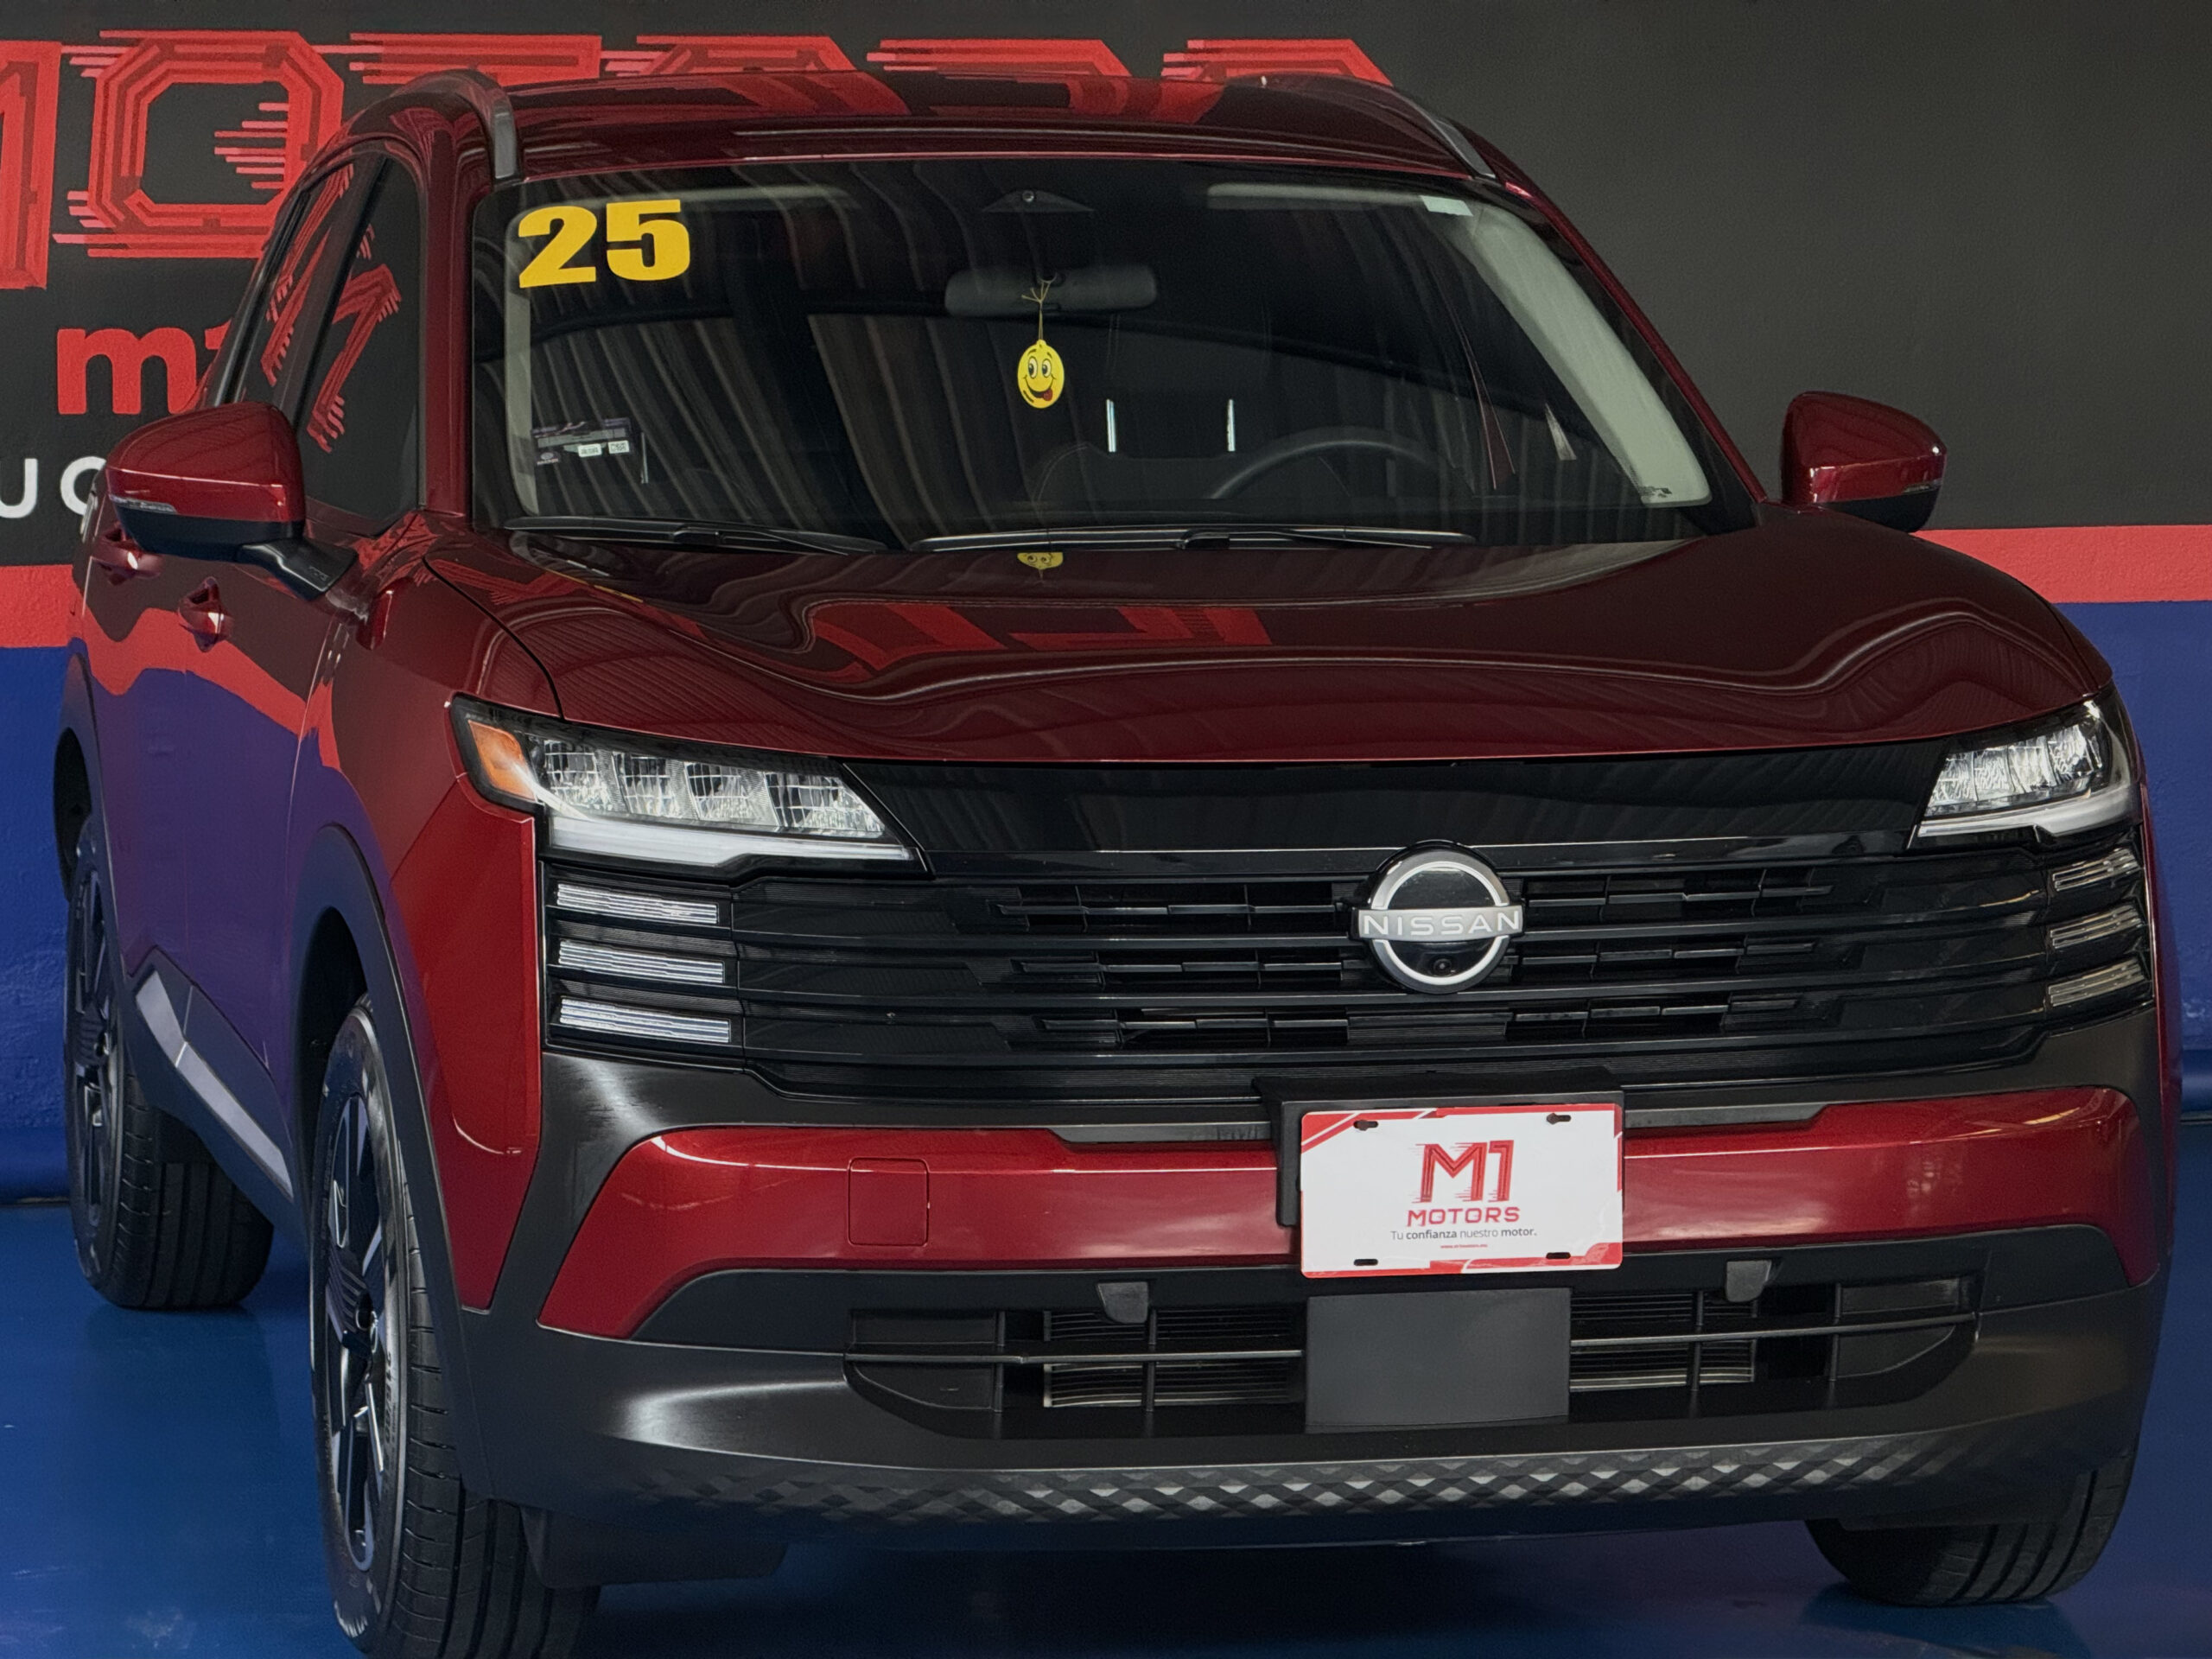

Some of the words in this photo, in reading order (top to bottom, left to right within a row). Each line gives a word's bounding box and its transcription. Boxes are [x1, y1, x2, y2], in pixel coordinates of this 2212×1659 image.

[518, 199, 690, 288] 25
[1363, 910, 1519, 936] NISSAN
[1414, 1140, 1515, 1204] M1
[1406, 1206, 1521, 1227] MOTORS
[1390, 1230, 1403, 1240] Tu
[1406, 1229, 1458, 1240] confianza
[1459, 1229, 1498, 1238] nuestro
[1501, 1228, 1537, 1237] motor.
